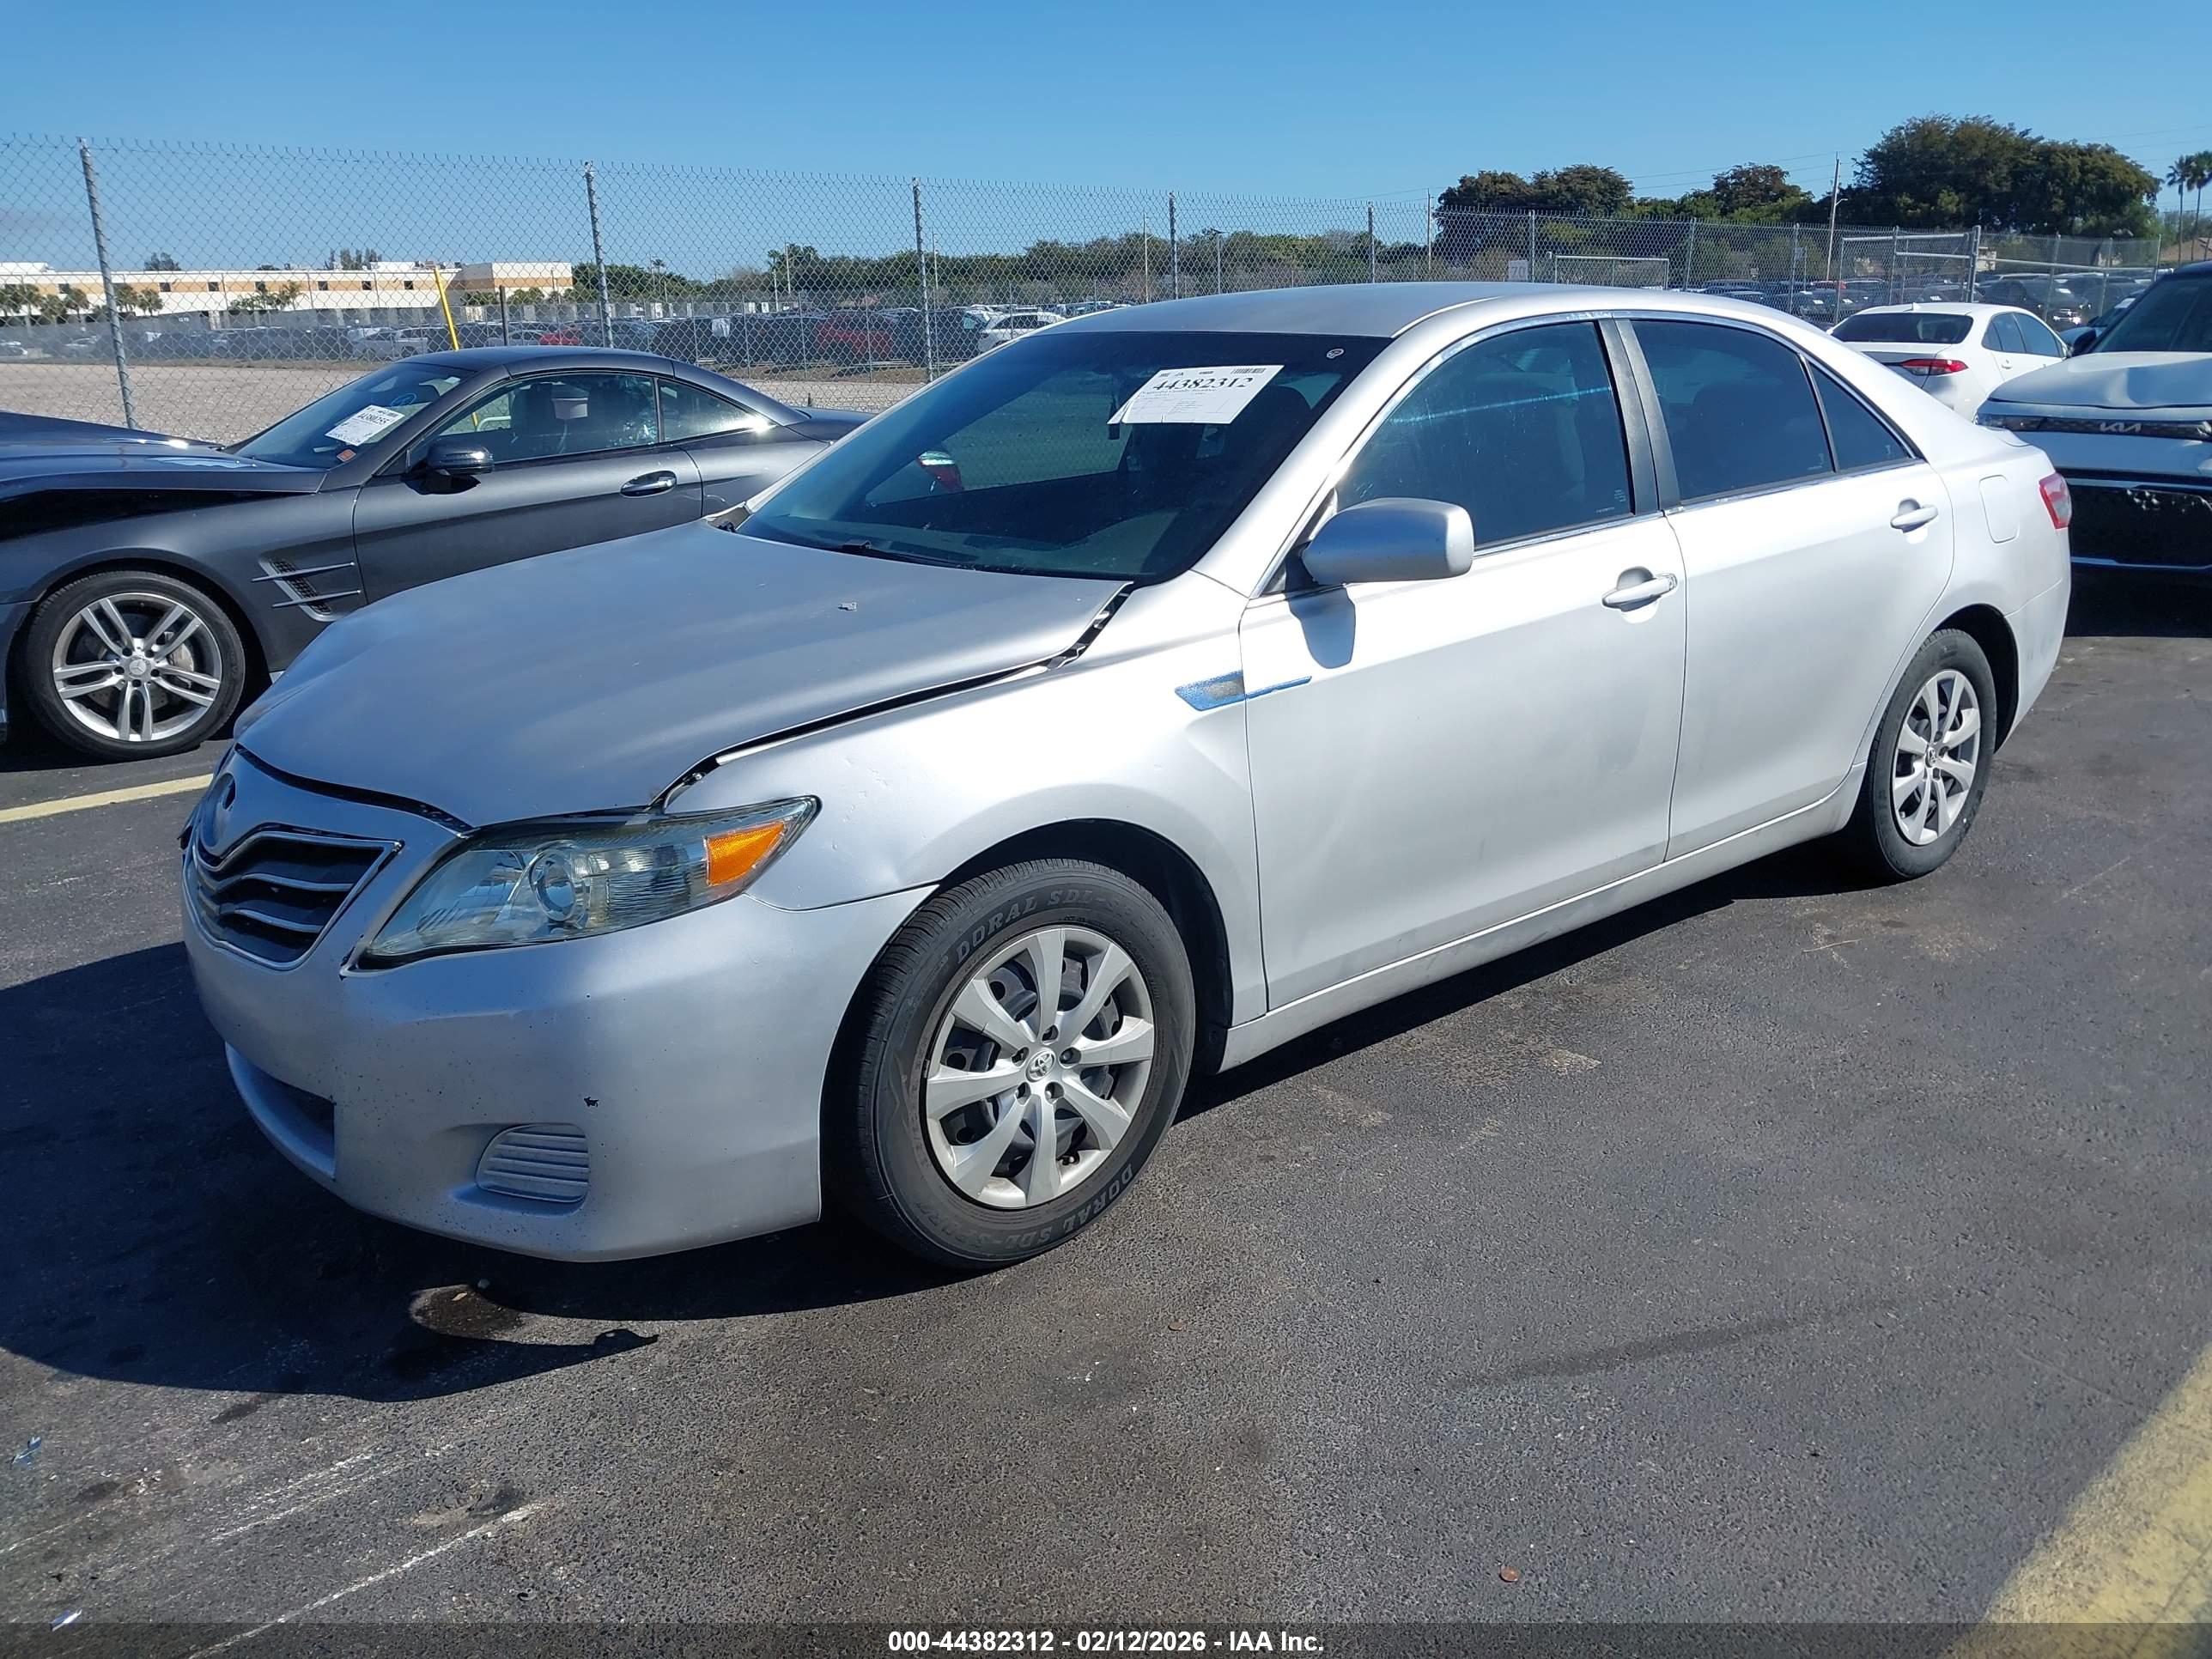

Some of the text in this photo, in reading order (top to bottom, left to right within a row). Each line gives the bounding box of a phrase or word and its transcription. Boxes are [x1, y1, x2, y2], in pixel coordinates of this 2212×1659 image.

[1153, 377, 1254, 391] 44382312
[2100, 422, 2142, 433] KIA
[956, 896, 1037, 963] DORAL
[1063, 1164, 1133, 1232] DORAL
